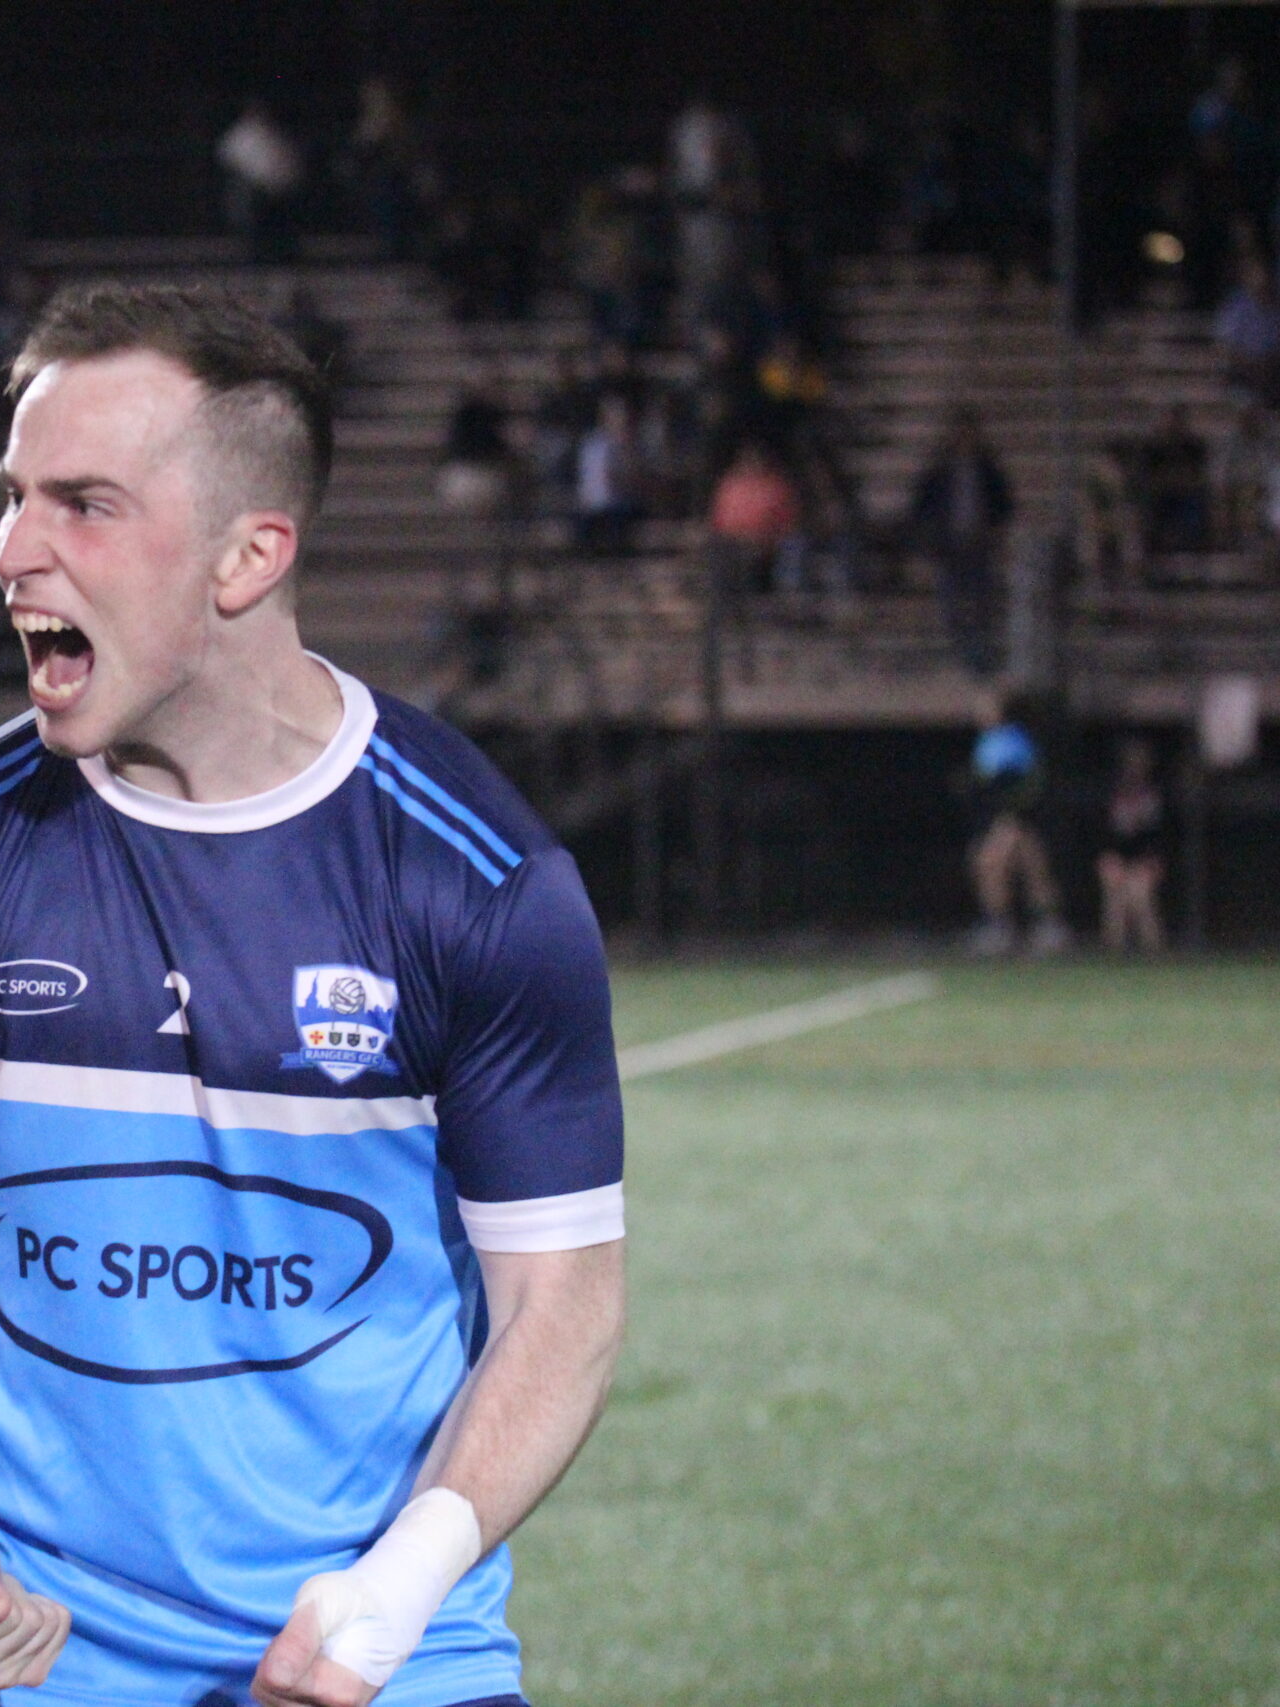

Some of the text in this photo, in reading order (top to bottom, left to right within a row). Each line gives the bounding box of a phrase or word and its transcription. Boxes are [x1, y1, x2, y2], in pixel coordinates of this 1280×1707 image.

[9, 979, 67, 997] SPORTS
[156, 970, 191, 1036] 2
[304, 1049, 357, 1062] RANGERS
[17, 1226, 314, 1311] PC SPORTS
